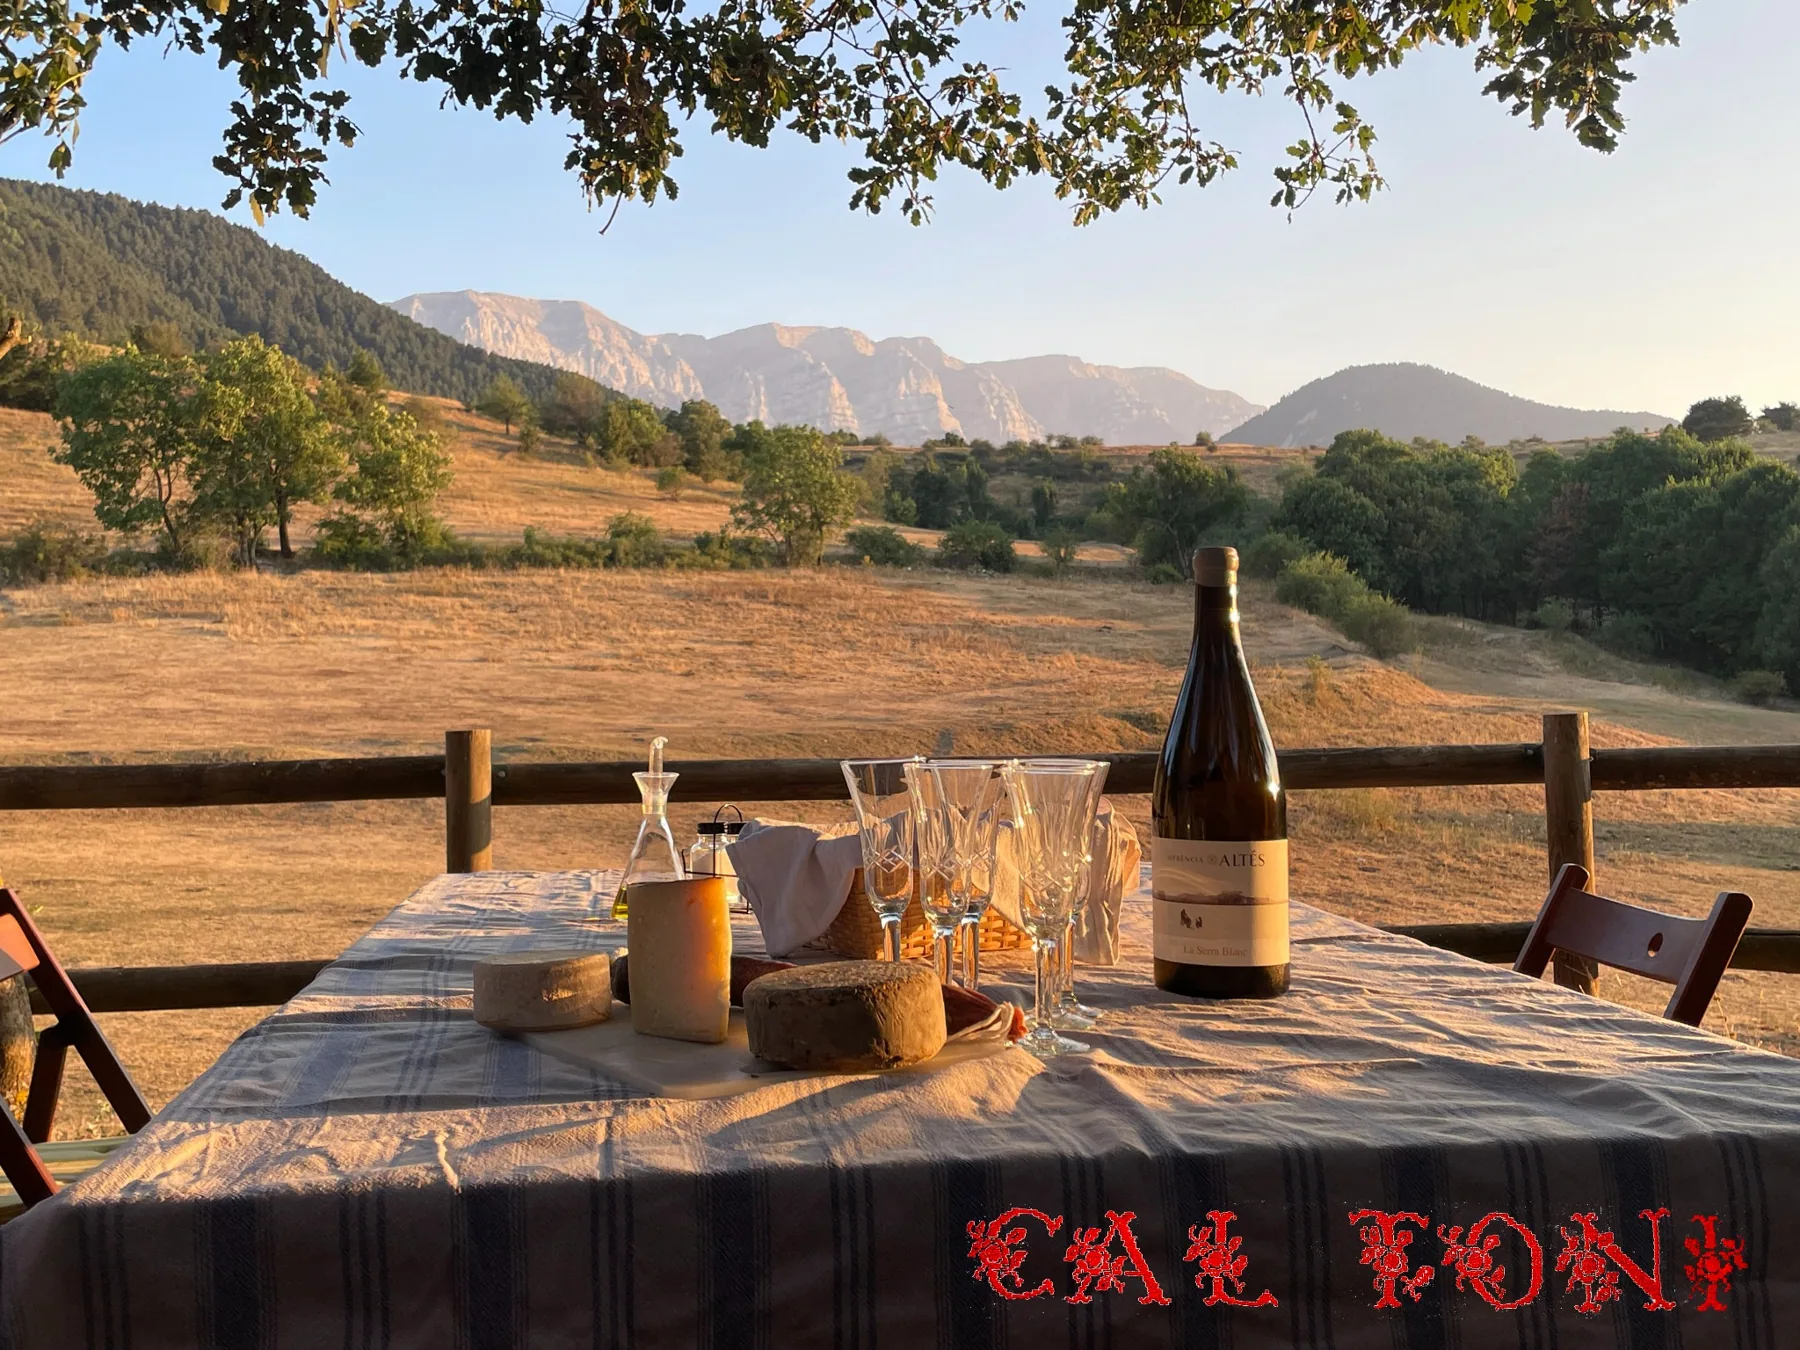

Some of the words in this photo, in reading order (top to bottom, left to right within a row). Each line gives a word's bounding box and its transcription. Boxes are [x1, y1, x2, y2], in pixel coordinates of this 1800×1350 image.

[1219, 849, 1265, 867] ALTÉS
[1183, 945, 1194, 954] La
[1196, 945, 1220, 956] Serra
[1222, 946, 1248, 957] Blanc
